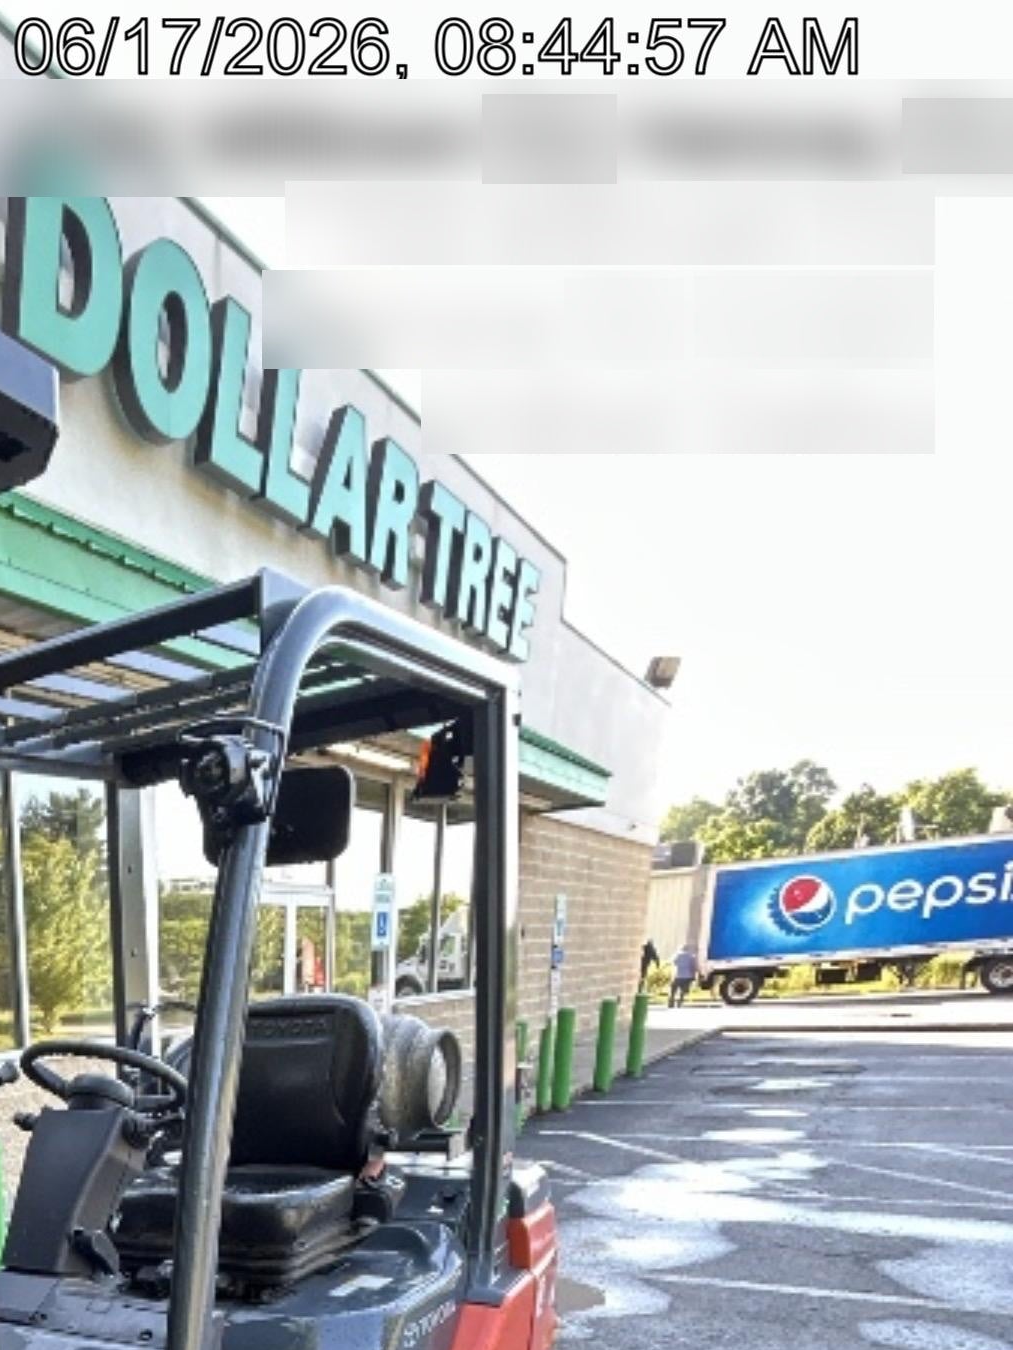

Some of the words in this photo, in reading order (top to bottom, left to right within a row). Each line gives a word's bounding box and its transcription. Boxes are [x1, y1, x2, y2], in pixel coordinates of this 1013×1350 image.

[6, 196, 419, 591] DOLLAR
[419, 480, 542, 663] TREE
[845, 860, 1013, 925] pepsi
